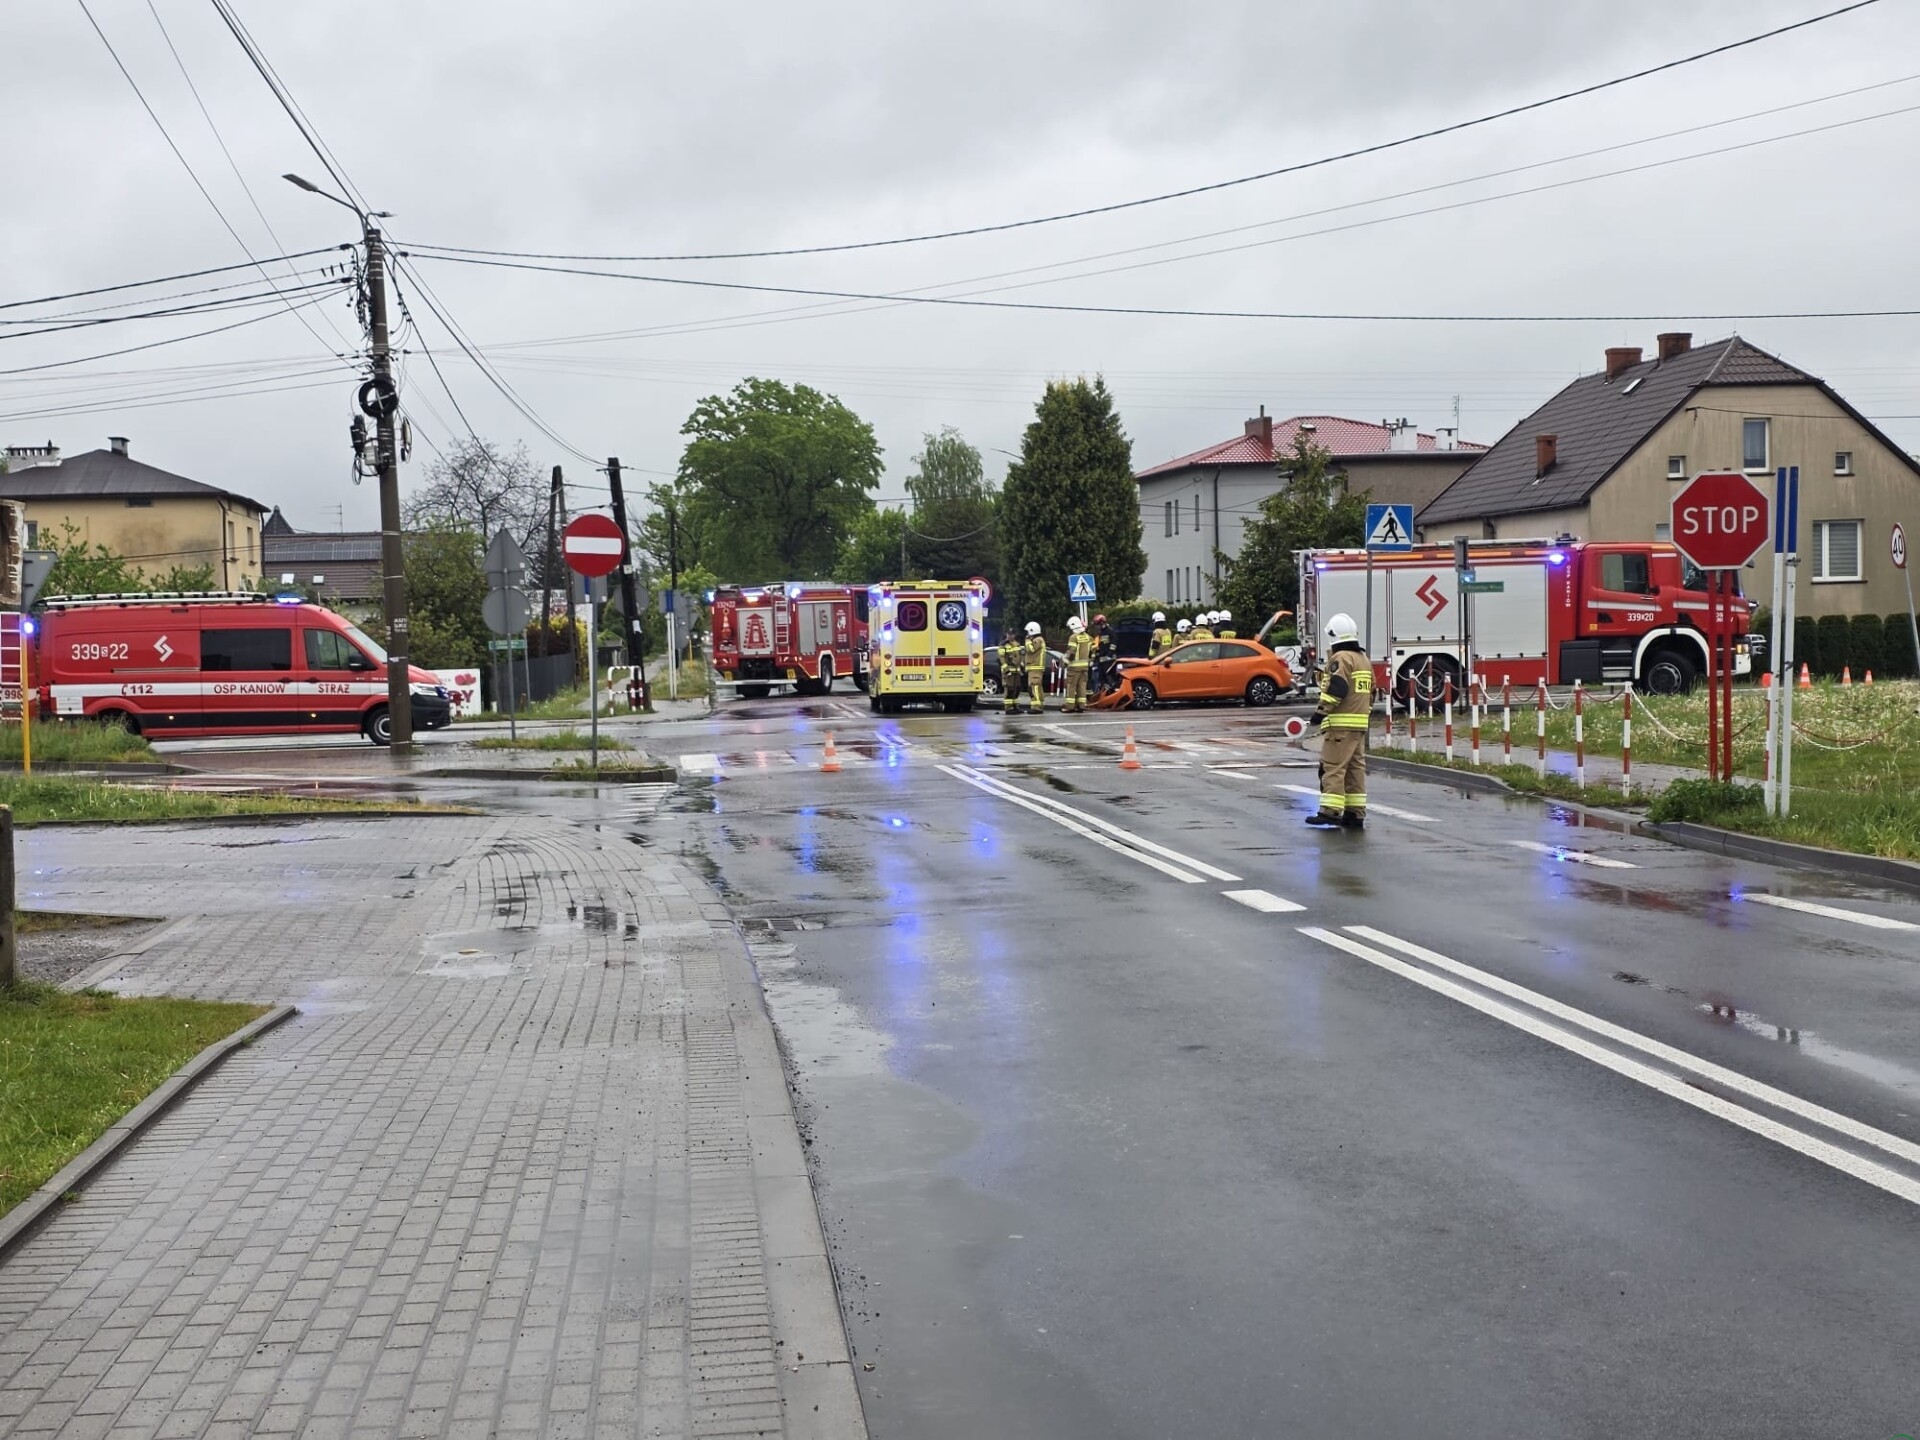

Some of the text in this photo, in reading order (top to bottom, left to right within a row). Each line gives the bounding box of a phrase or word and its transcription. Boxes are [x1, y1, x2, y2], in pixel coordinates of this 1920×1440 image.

[1683, 506, 1759, 534] STOP
[1893, 534, 1904, 558] 40
[71, 643, 128, 660] 339S22
[130, 685, 153, 694] 112
[213, 684, 237, 694] OSP
